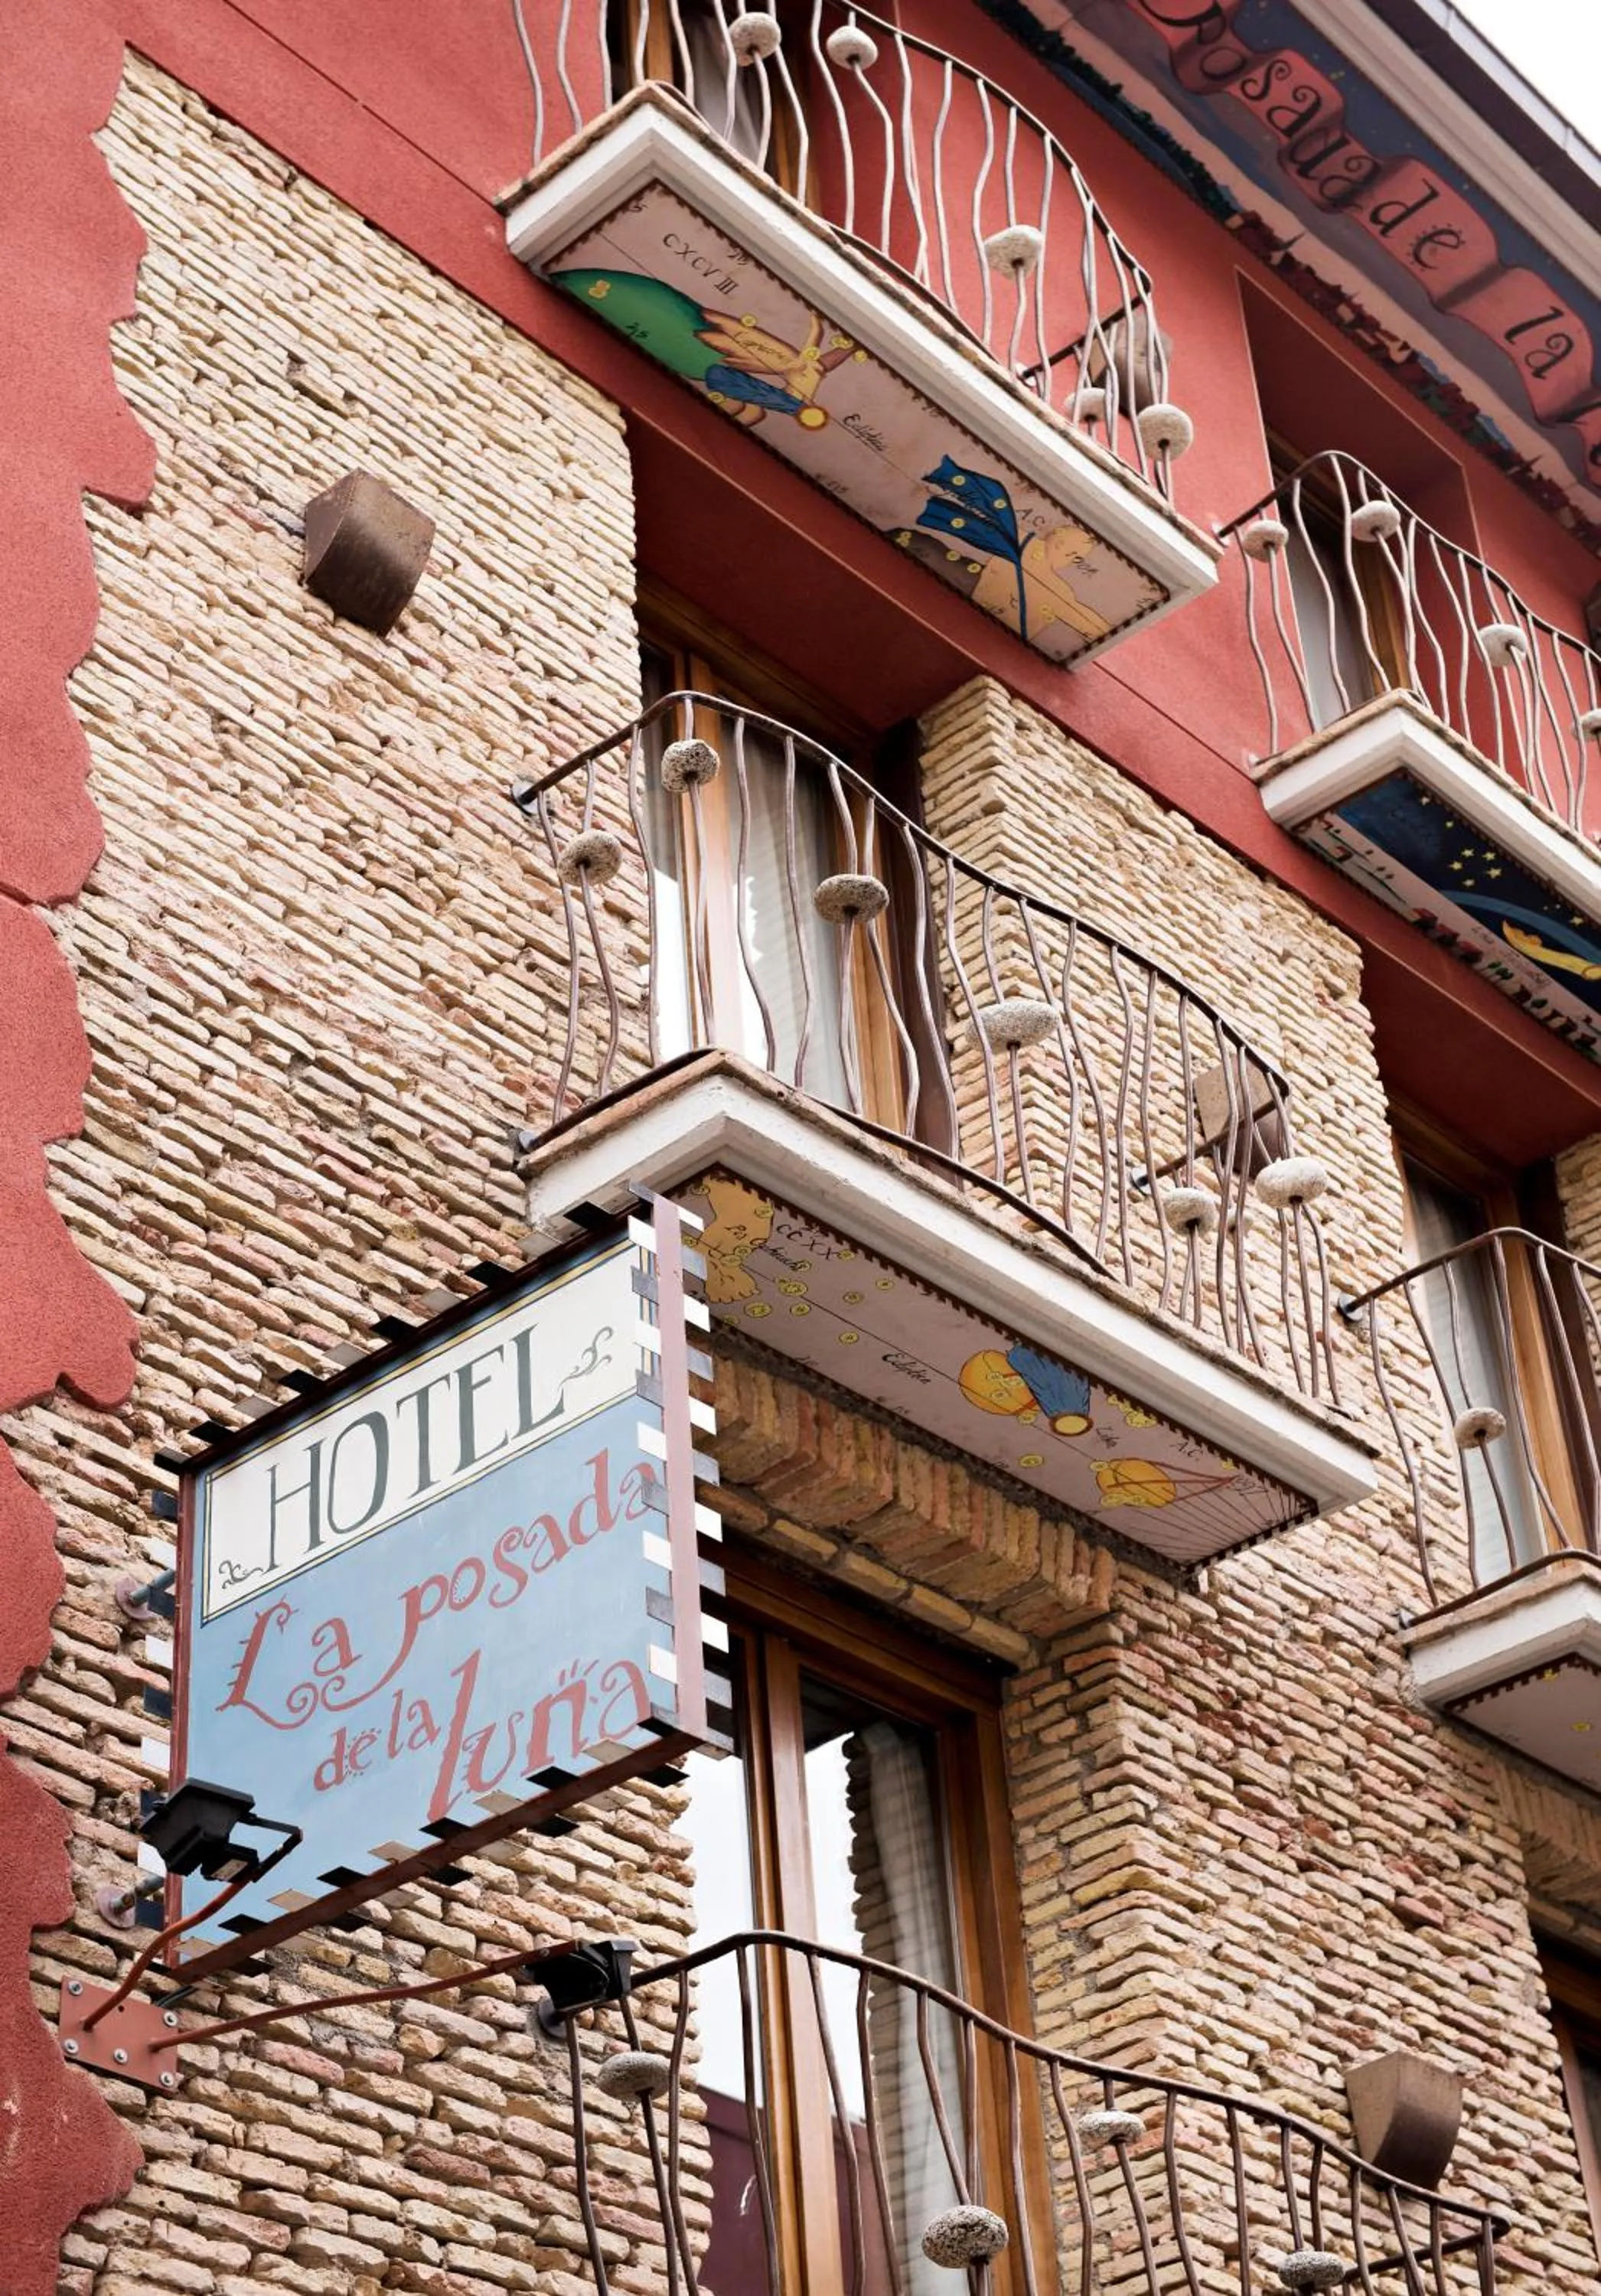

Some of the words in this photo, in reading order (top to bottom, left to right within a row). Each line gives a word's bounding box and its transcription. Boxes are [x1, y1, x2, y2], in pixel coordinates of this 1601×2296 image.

[1368, 178, 1465, 270] de
[1504, 305, 1574, 380] la
[262, 1322, 566, 1575] HOTEL
[215, 1594, 363, 1730] La
[321, 1447, 658, 1712] posada
[314, 1727, 381, 1792] de
[387, 1689, 442, 1760] la
[426, 1649, 651, 1823] luna
